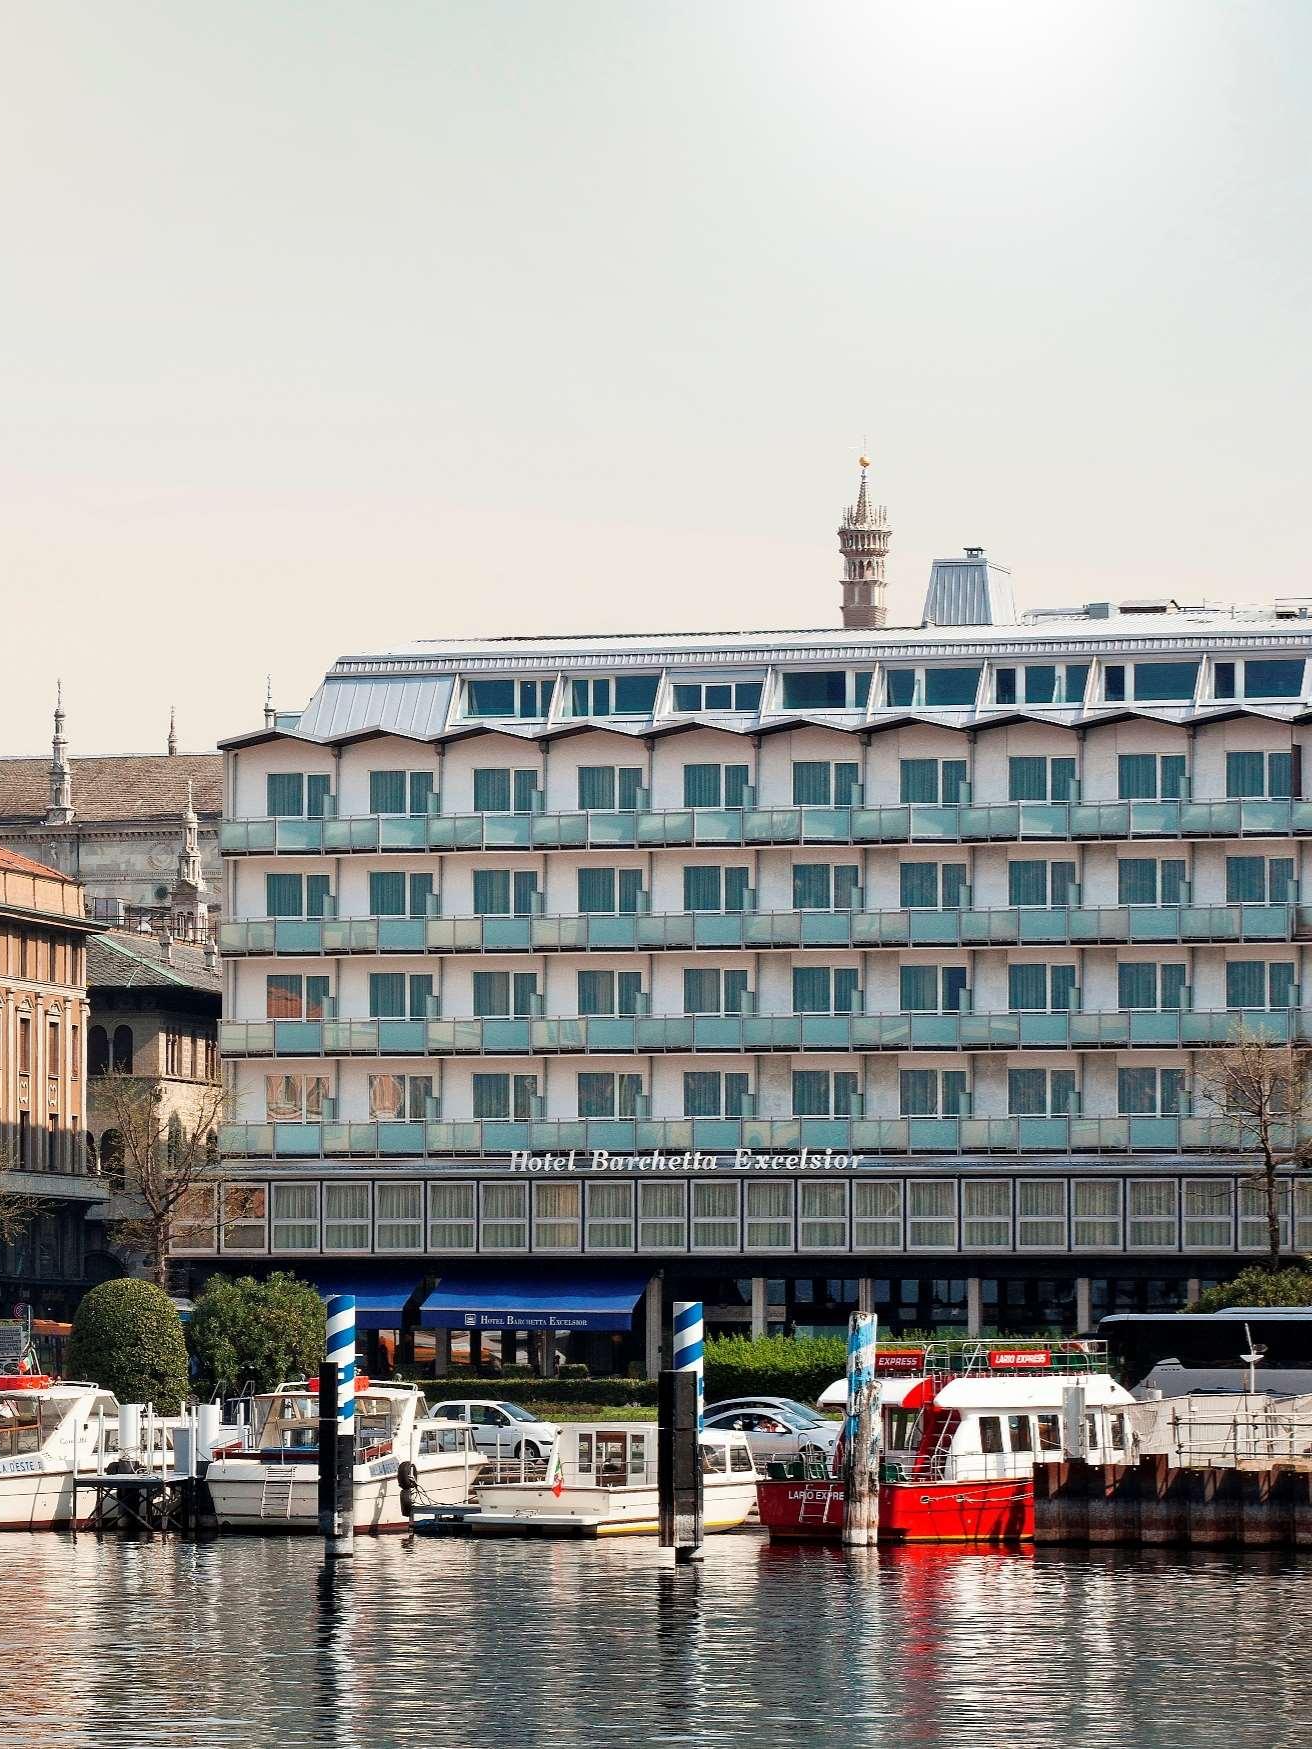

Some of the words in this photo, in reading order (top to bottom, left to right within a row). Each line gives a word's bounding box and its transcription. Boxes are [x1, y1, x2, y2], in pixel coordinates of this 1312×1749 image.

[508, 1149, 576, 1173] Hotel
[590, 1149, 718, 1172] Barchetta
[732, 1147, 865, 1171] Excelsior
[878, 1357, 918, 1366] EXPRESS
[995, 1354, 1016, 1364] LARIO
[1015, 1353, 1047, 1364] EXPRESS
